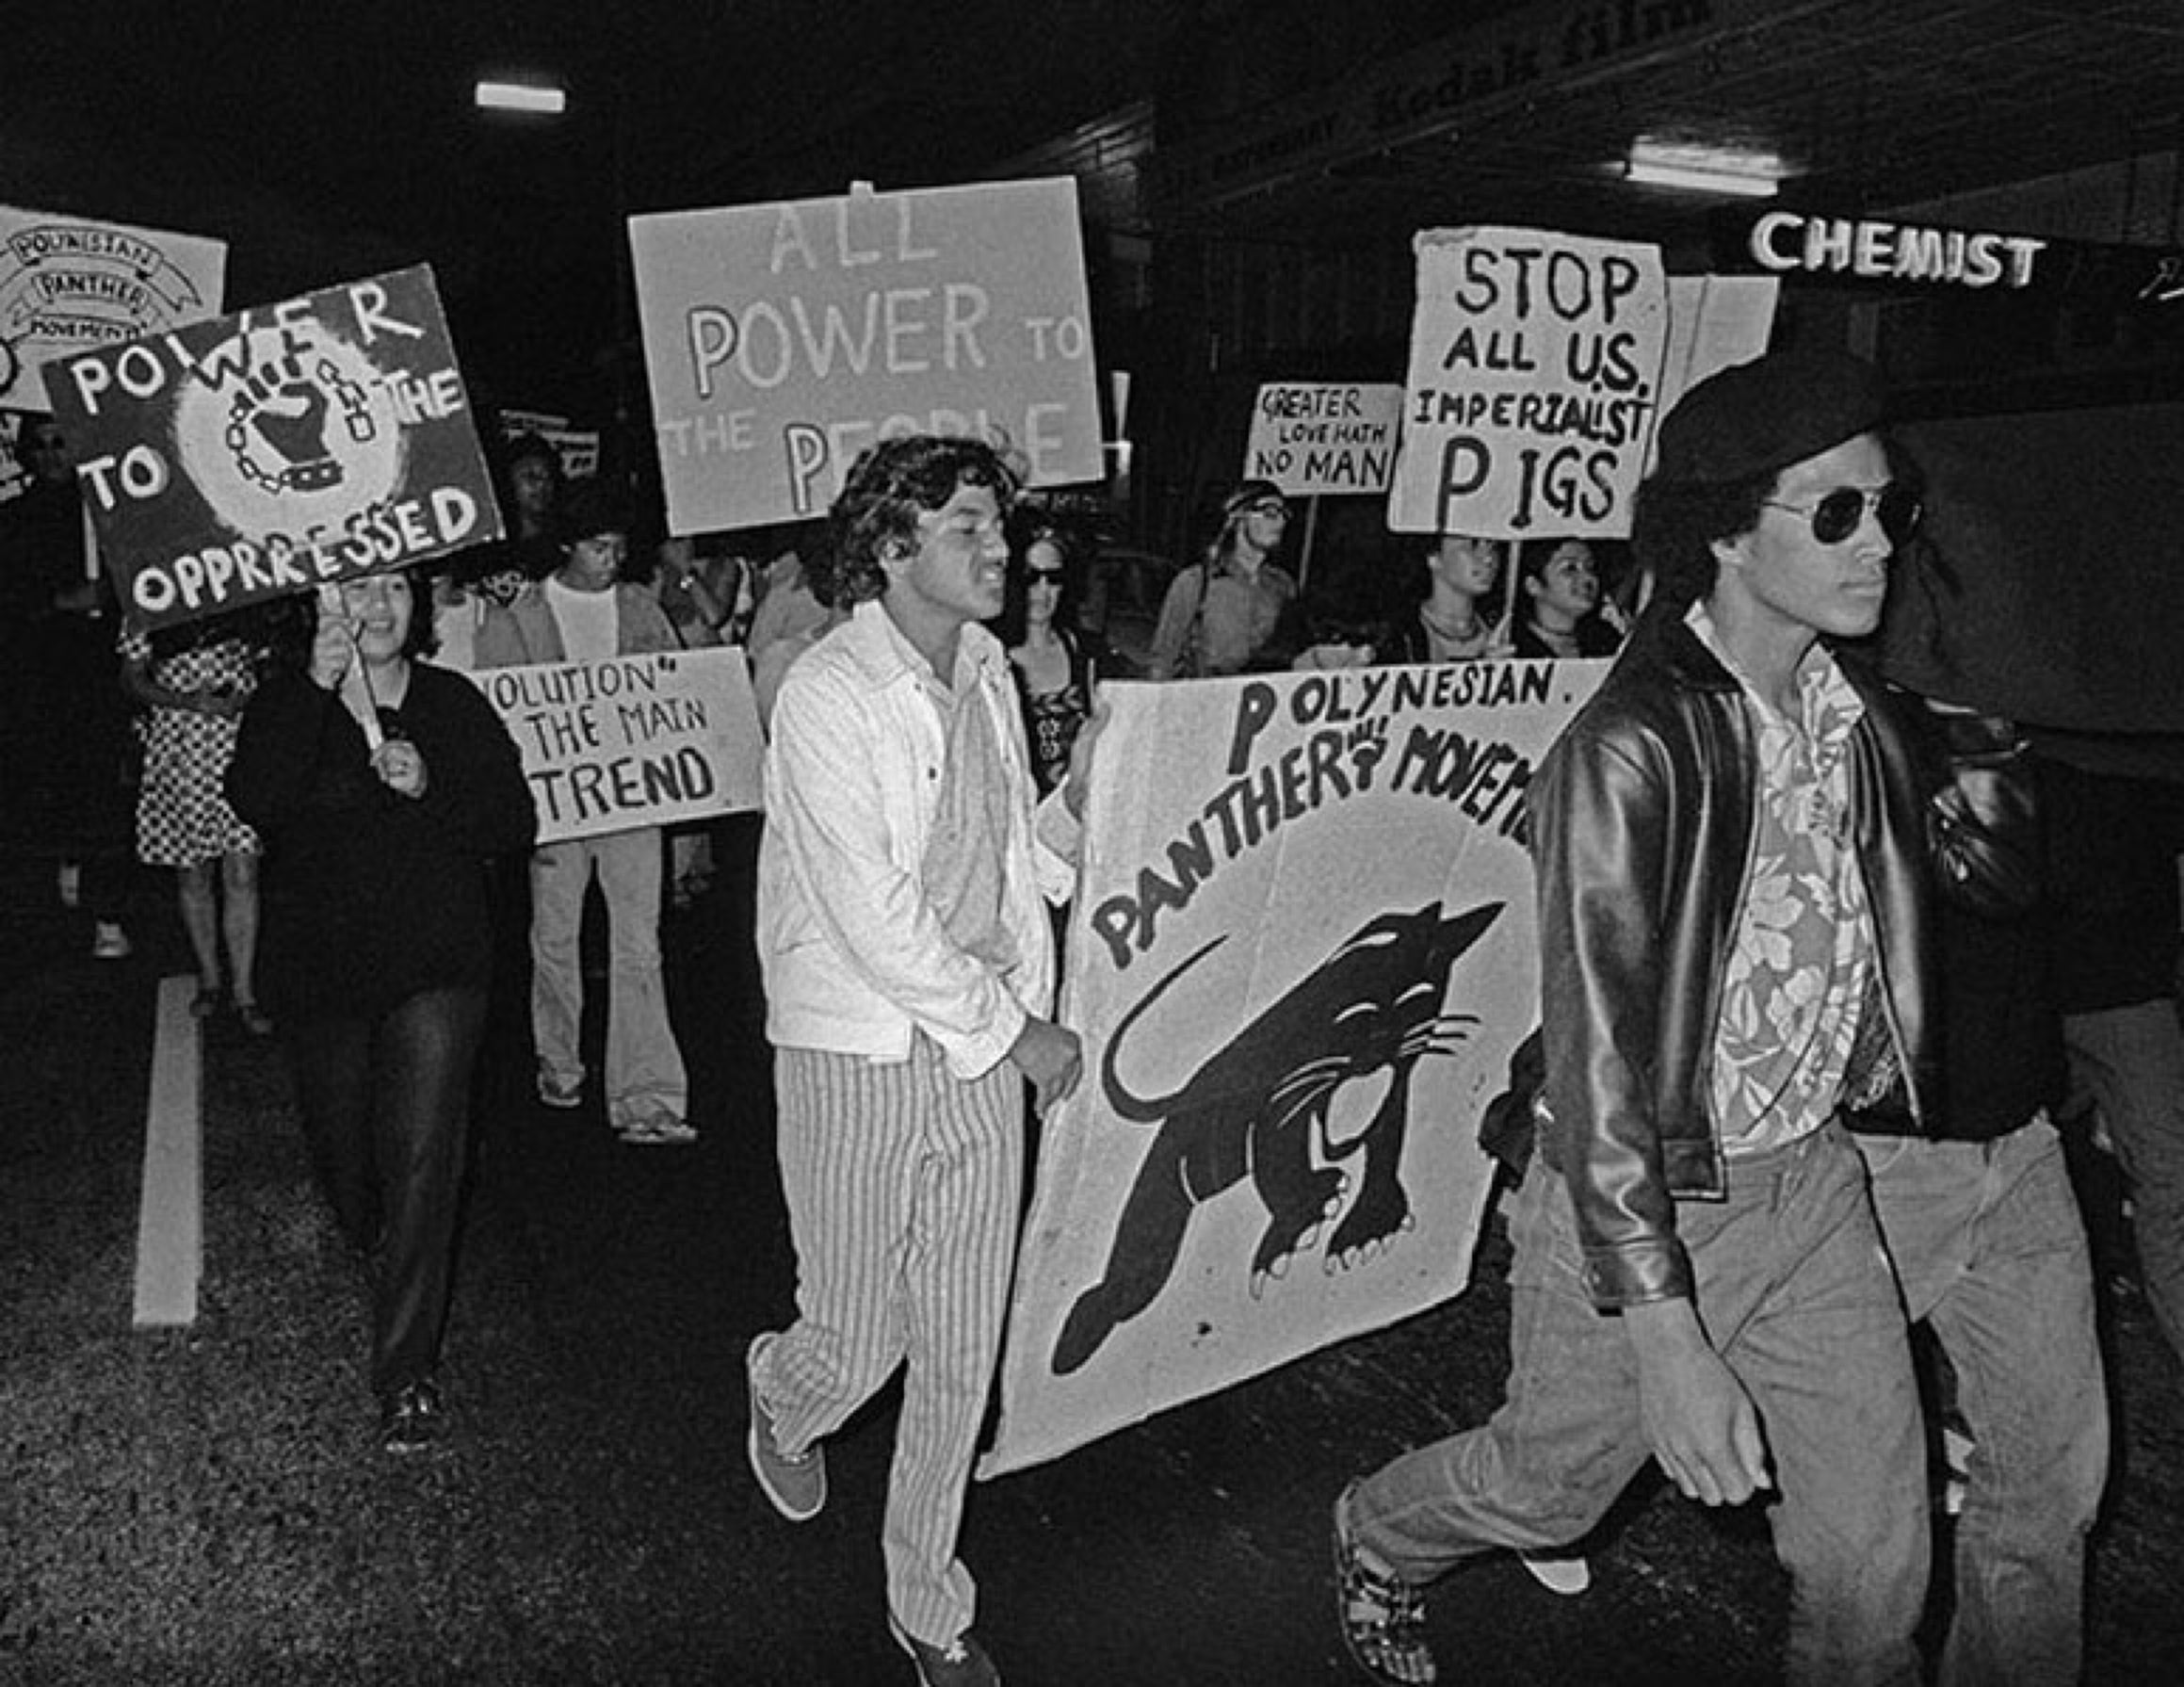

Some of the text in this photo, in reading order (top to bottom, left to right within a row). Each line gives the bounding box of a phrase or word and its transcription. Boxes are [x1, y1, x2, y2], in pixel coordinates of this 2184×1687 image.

[770, 193, 939, 273] ALL
[1750, 211, 2046, 287] CHEMIST
[41, 273, 143, 306] PANTHER
[1455, 248, 1639, 324] STOP
[71, 281, 425, 414] POWER
[688, 283, 1085, 399] POWER TO
[1443, 326, 1536, 370] ALL
[371, 367, 462, 424] THE
[1262, 387, 1362, 422] GREATER
[1414, 388, 1656, 447] IMPERIALIST
[658, 409, 753, 456] THE
[1279, 423, 1388, 445] LOVE HATH
[77, 446, 170, 510] TO
[1256, 448, 1388, 487] NO MAN
[524, 698, 707, 761] THE MAIN
[527, 747, 714, 821] TREND
[1090, 731, 1351, 969] PANTHER
